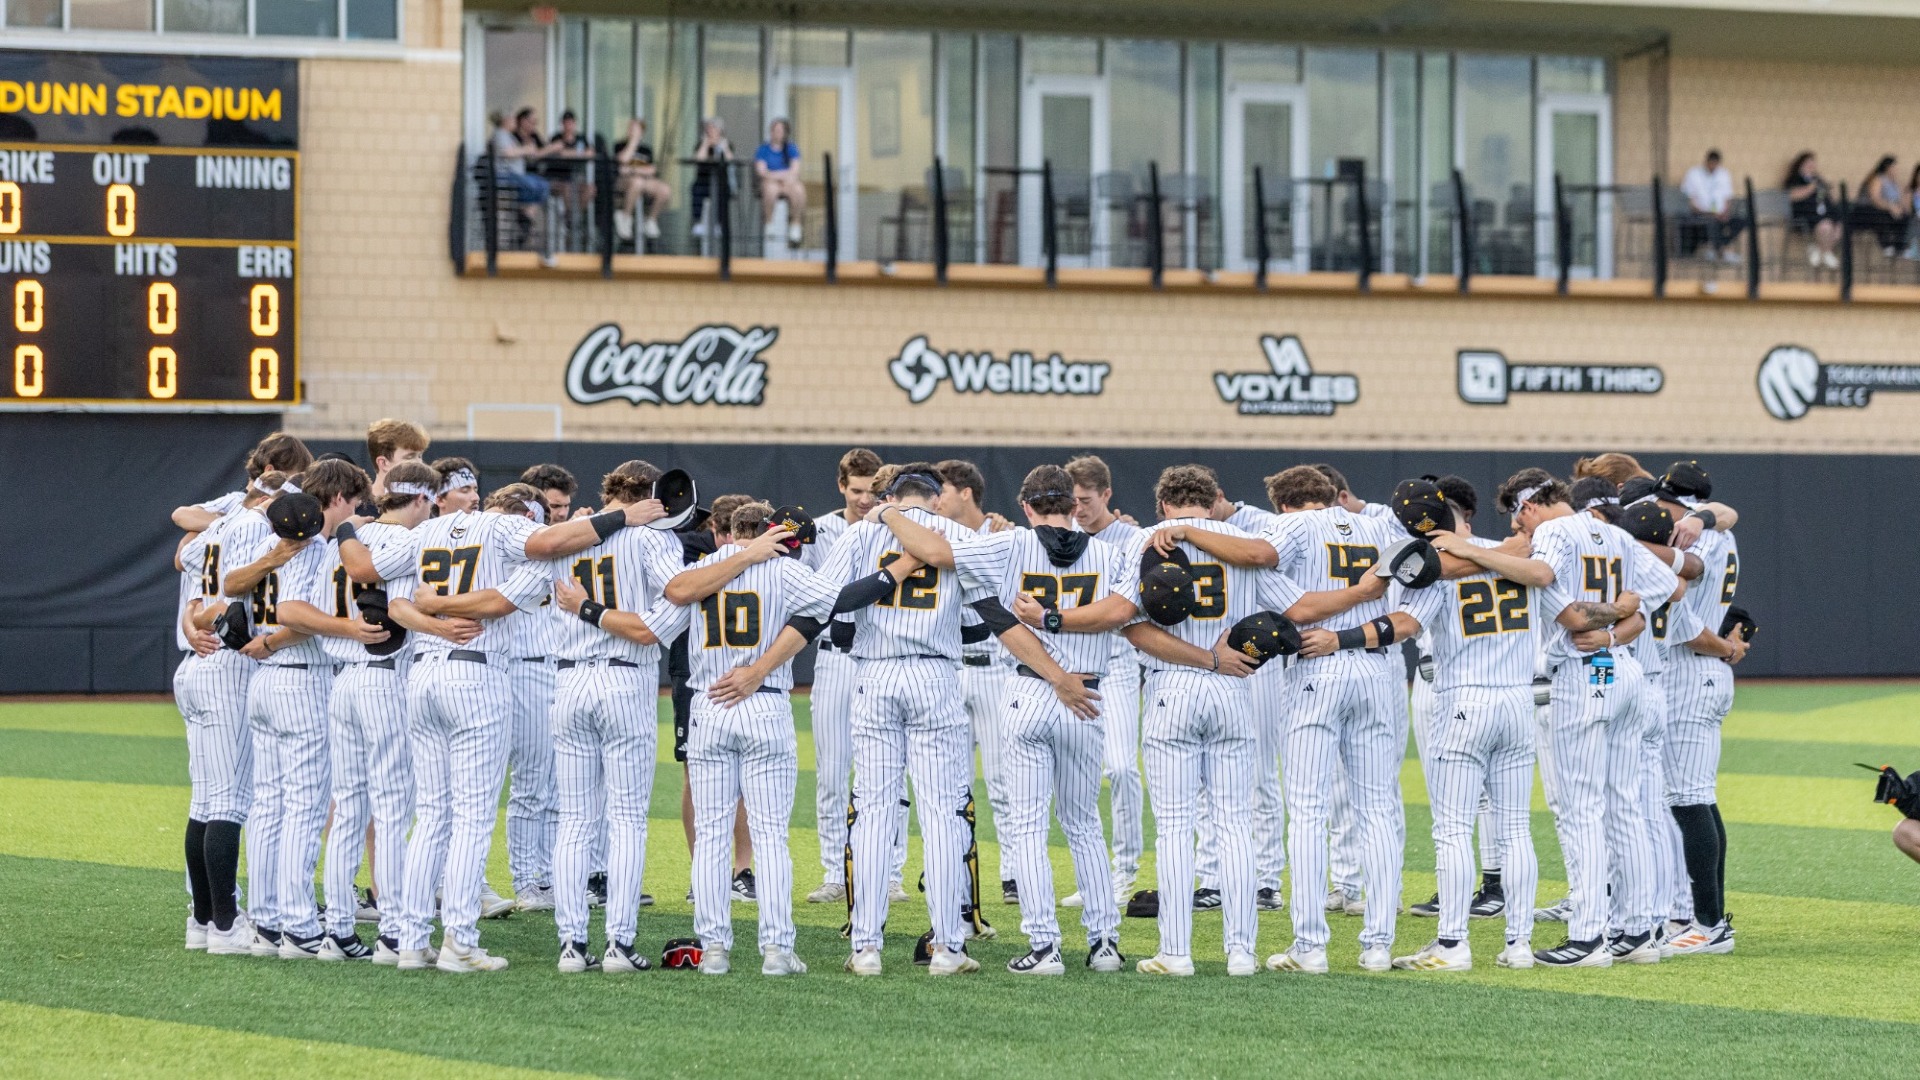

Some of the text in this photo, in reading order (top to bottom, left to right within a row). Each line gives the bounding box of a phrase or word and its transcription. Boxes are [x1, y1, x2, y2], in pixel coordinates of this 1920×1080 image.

[0, 81, 282, 122] DUNN STADIUM
[92, 153, 149, 186] OUT
[195, 155, 291, 190] INNING
[0, 181, 21, 234] 0
[107, 183, 135, 237] 0
[115, 243, 178, 277] HITS
[237, 246, 292, 278] ERR
[15, 279, 279, 337] 0 0 0
[15, 344, 279, 400] 0 0 0
[566, 324, 778, 405] Coca-Cola
[947, 351, 1110, 395] Wellstar
[1214, 373, 1358, 402] VOYLES
[1510, 365, 1583, 392] FIFTH
[1587, 366, 1664, 393] THIRD
[421, 544, 483, 597] 27
[571, 554, 619, 610] 11
[875, 550, 940, 611] 12
[1582, 555, 1623, 604] 41
[700, 590, 762, 649] 10
[1457, 578, 1530, 639] 22
